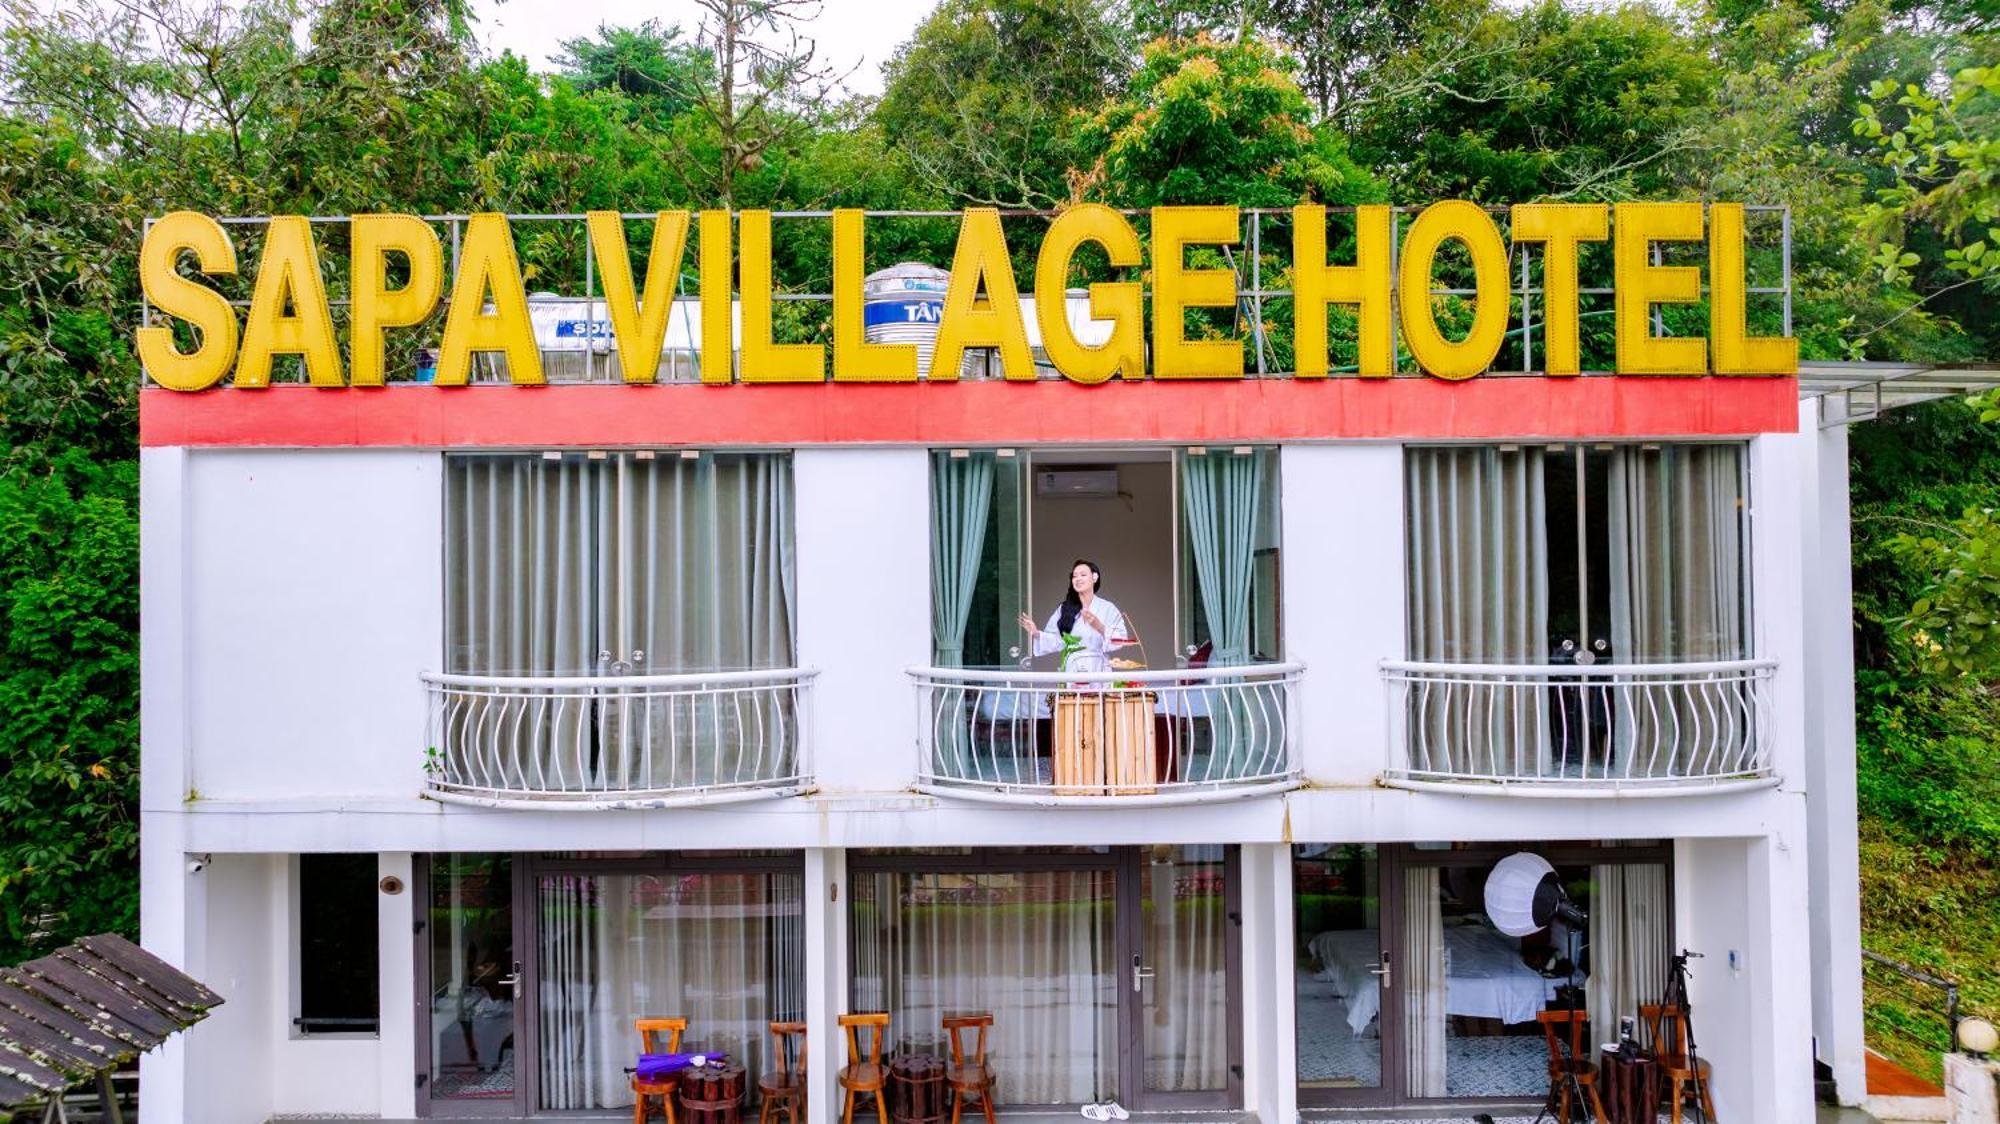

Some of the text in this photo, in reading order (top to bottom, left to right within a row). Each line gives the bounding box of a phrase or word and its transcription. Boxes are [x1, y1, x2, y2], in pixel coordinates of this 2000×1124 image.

[137, 199, 1798, 391] SAPA VILLAGE HOTEL
